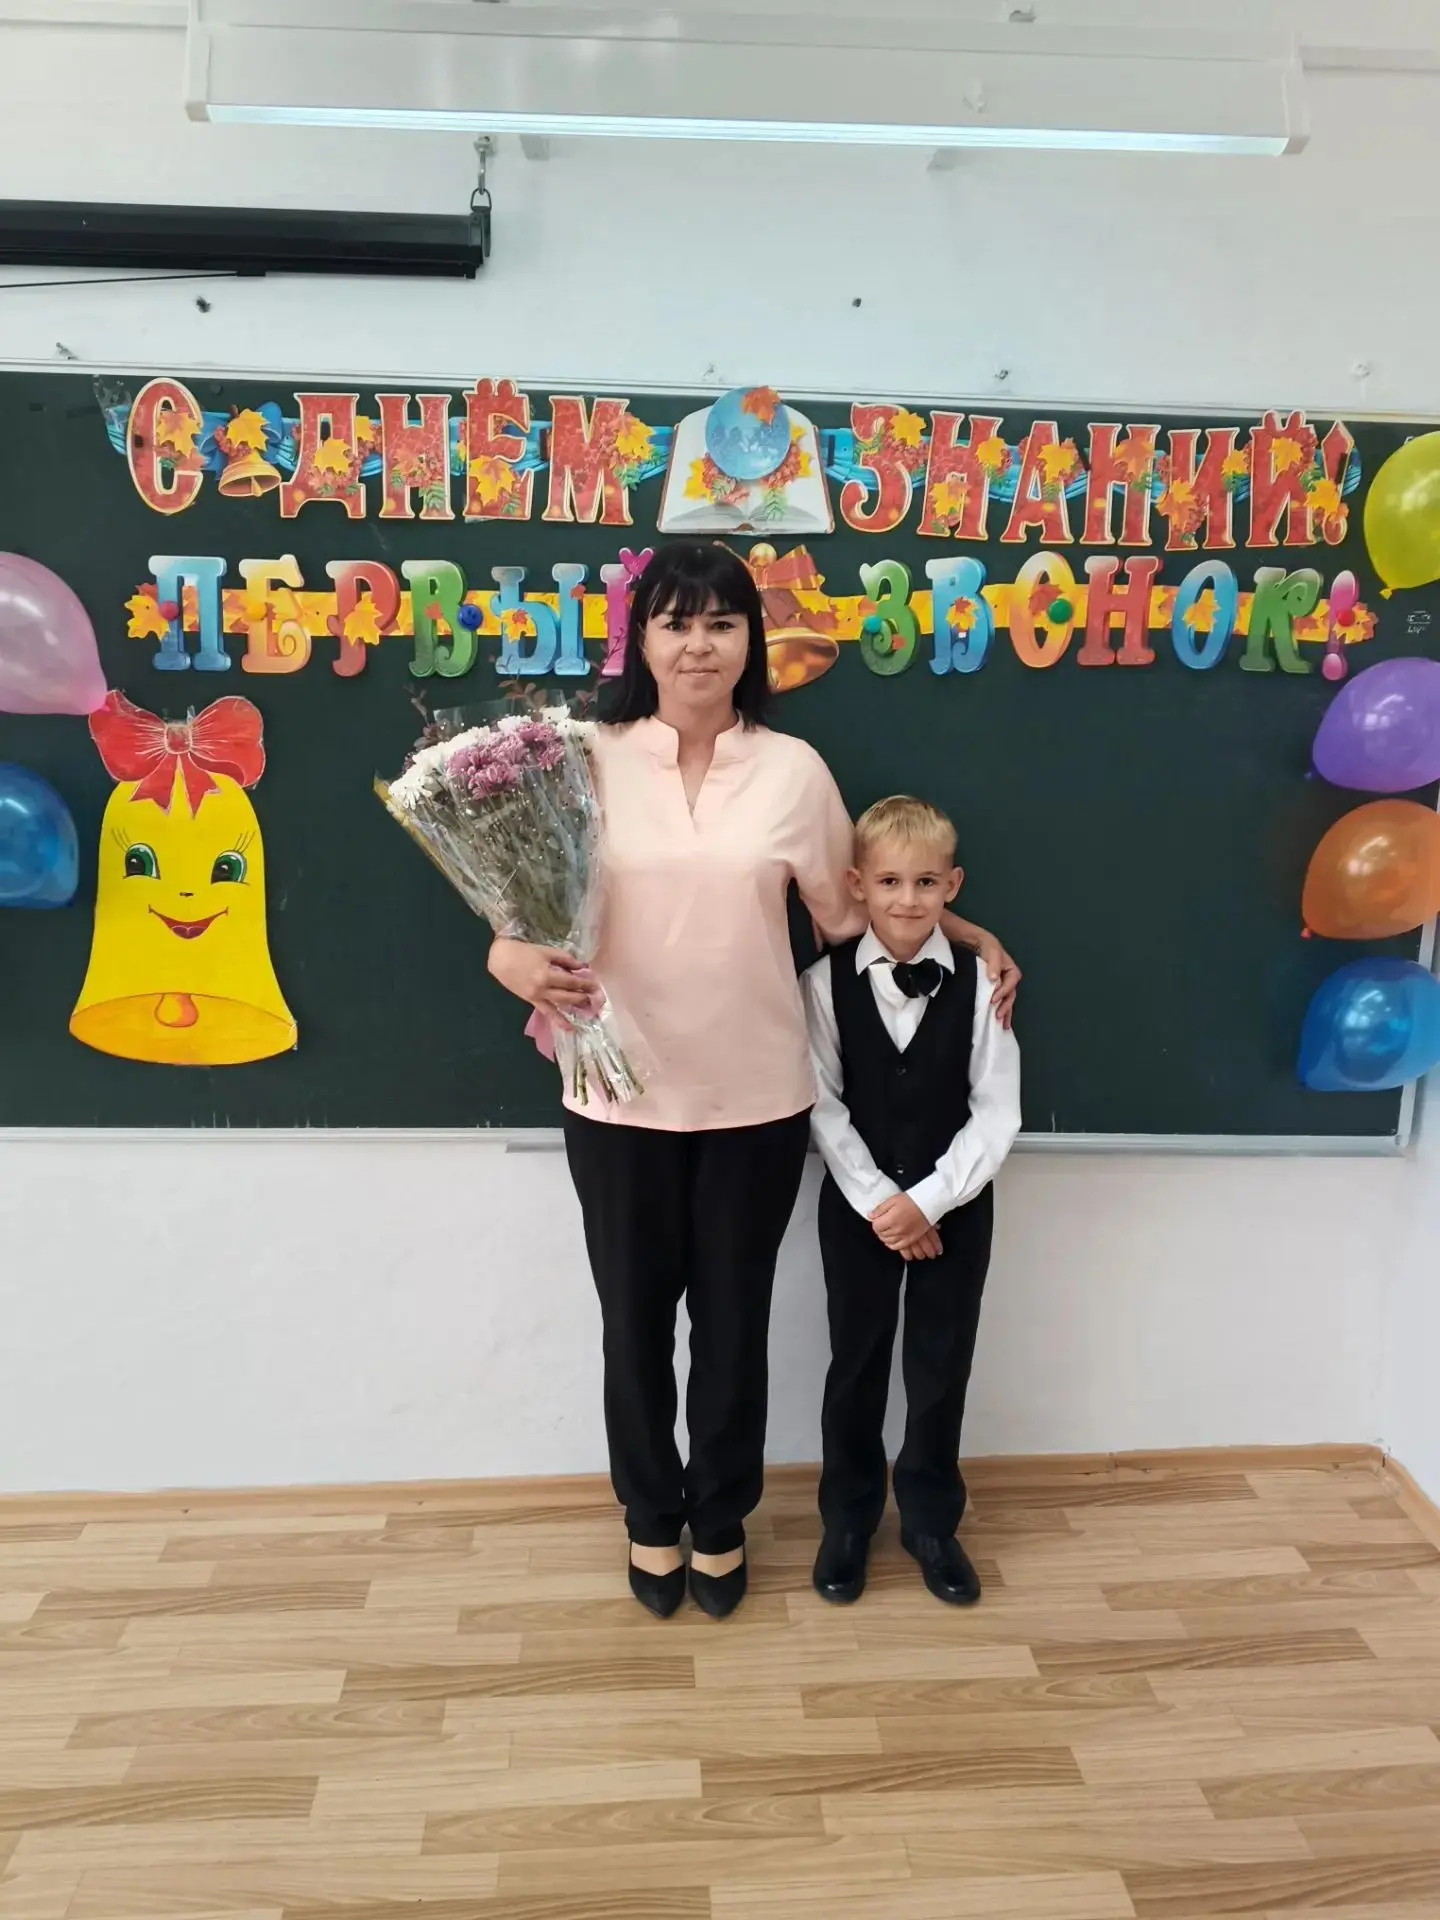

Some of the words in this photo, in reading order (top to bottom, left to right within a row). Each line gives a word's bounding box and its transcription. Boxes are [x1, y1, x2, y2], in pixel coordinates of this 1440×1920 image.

[127, 377, 204, 515] С
[280, 378, 634, 525] ДНЁМ
[840, 401, 1354, 551] ЗНАНИЙ!
[859, 551, 1359, 681] ЗВОНОК!
